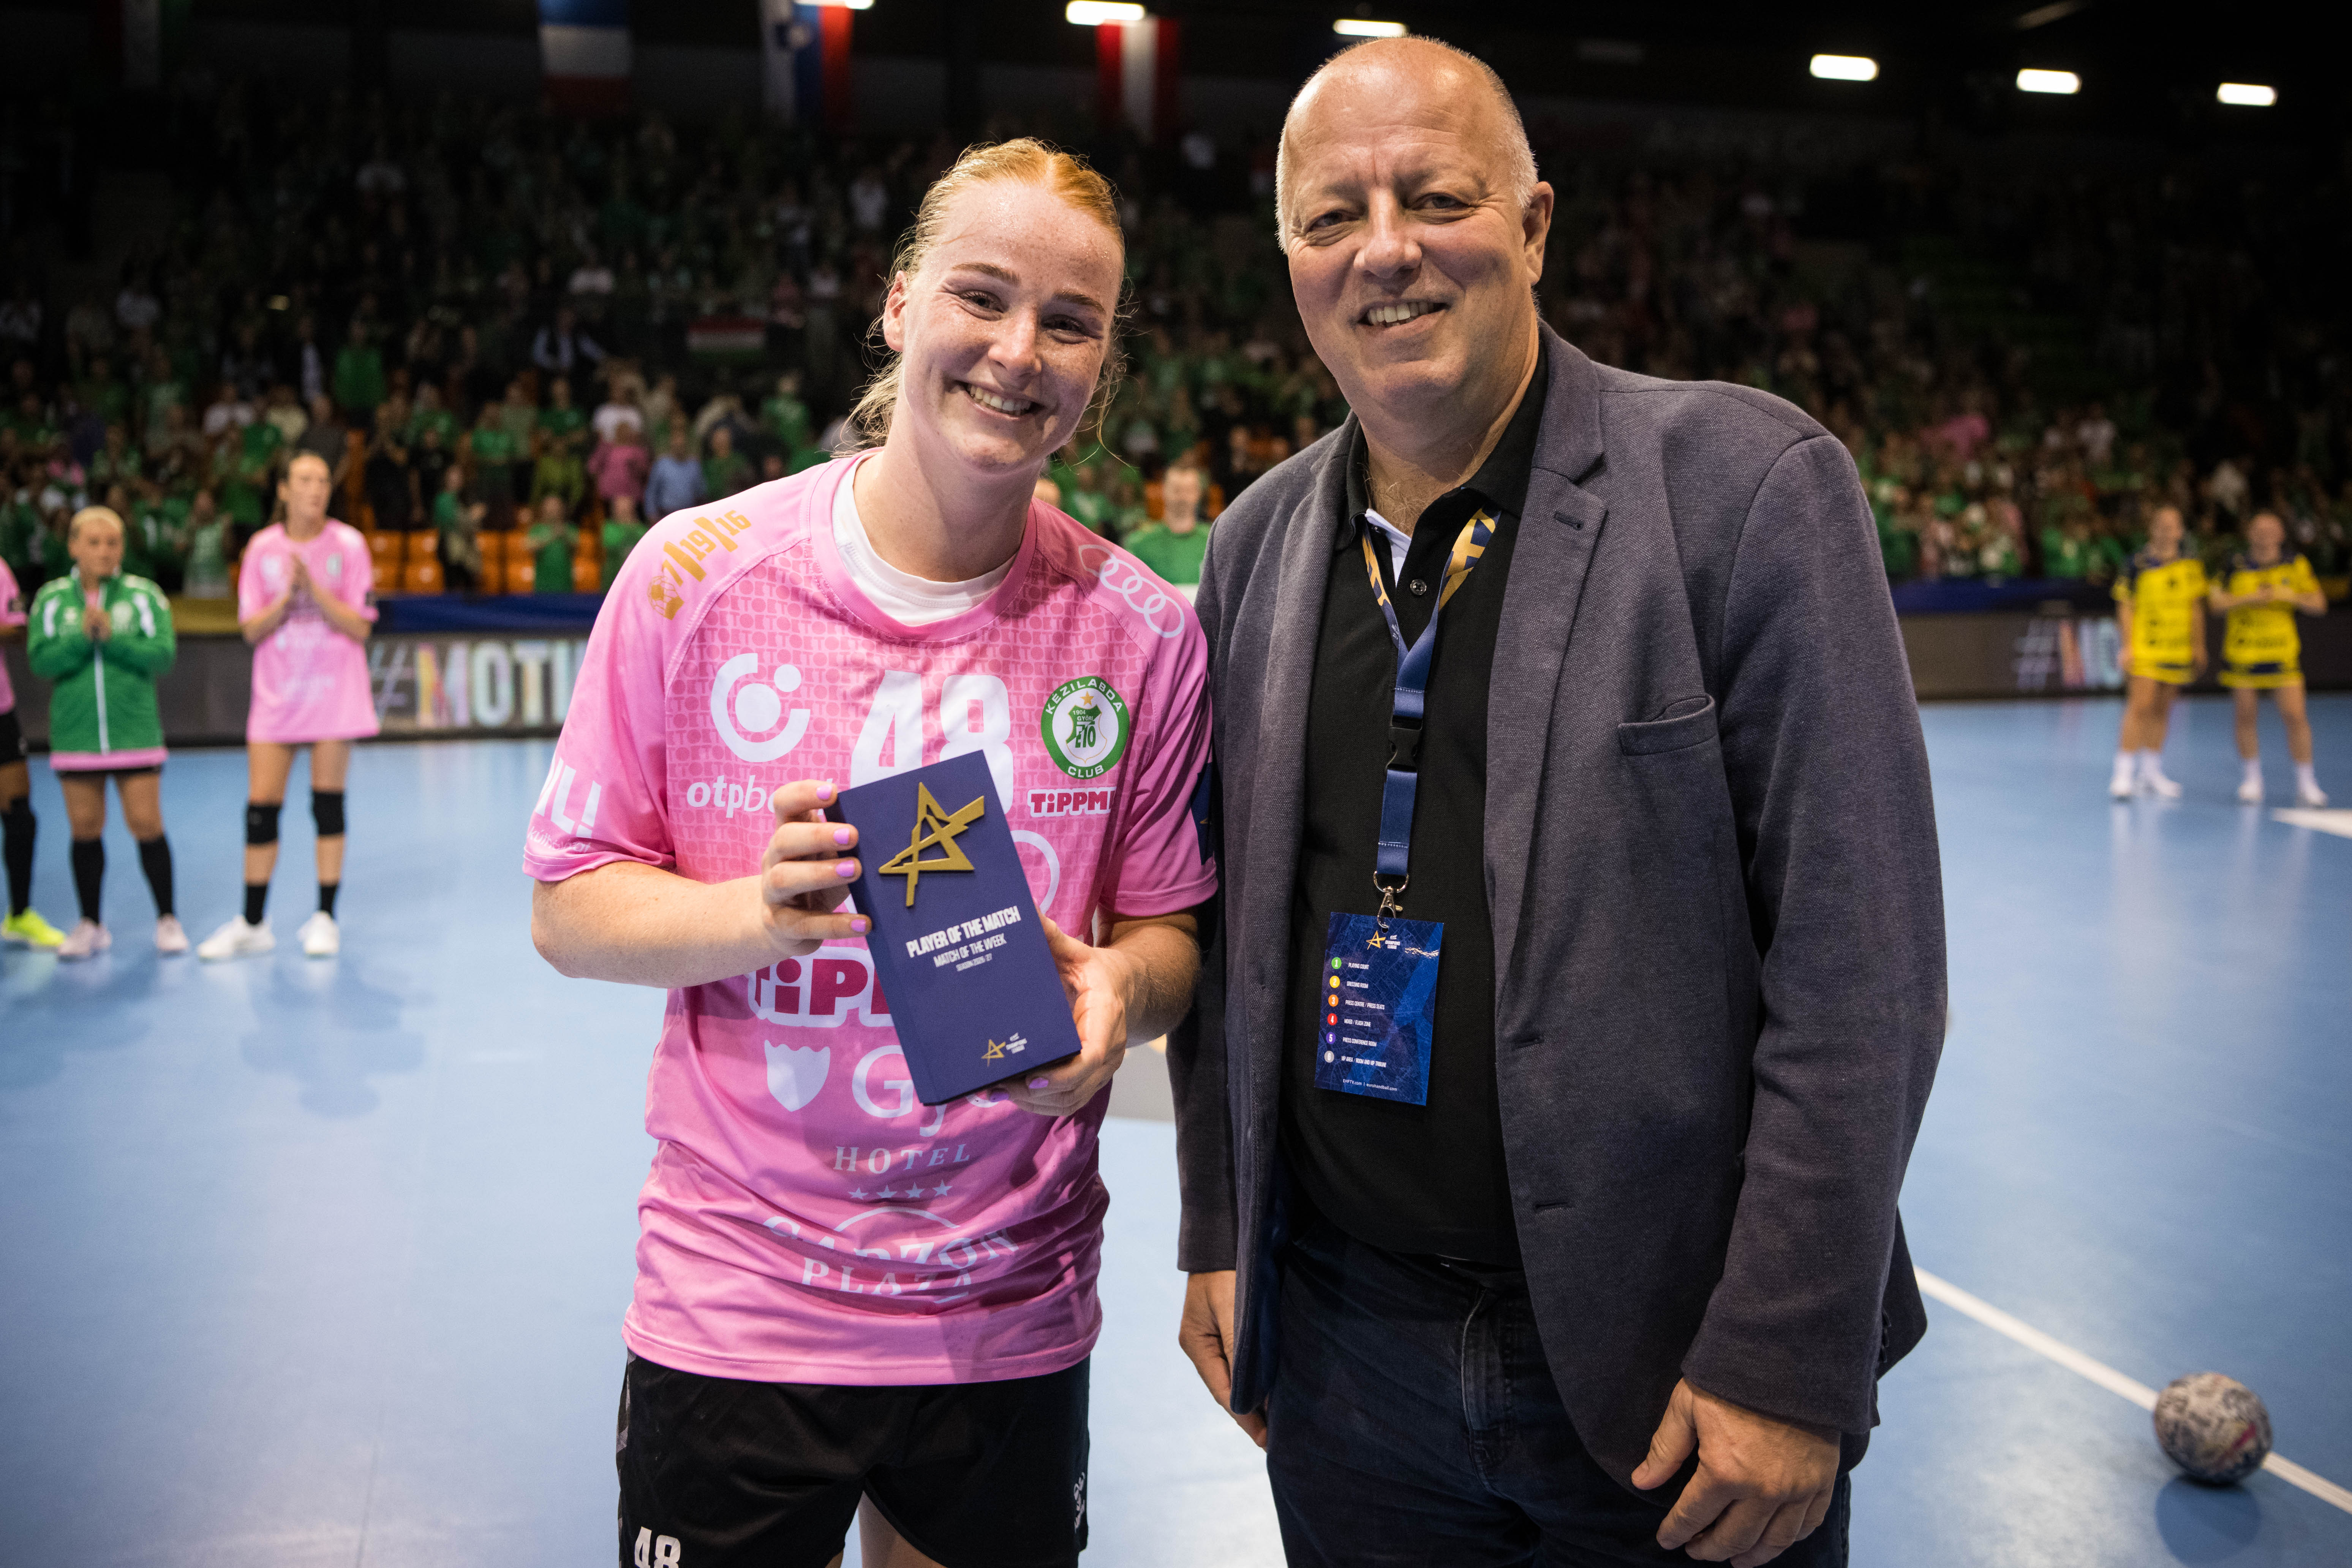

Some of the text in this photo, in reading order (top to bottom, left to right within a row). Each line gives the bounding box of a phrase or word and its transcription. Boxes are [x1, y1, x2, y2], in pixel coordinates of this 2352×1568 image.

[1045, 678, 1122, 715] KÉZILABDA
[850, 669, 1013, 814] 48
[1067, 764, 1104, 778] CLUB
[906, 906, 1021, 958] PLAYER OF THE MATCH
[933, 933, 1007, 967] MATCH OF THE WEEK
[833, 1143, 971, 1174] HOTEL
[634, 1526, 681, 1568] 48
